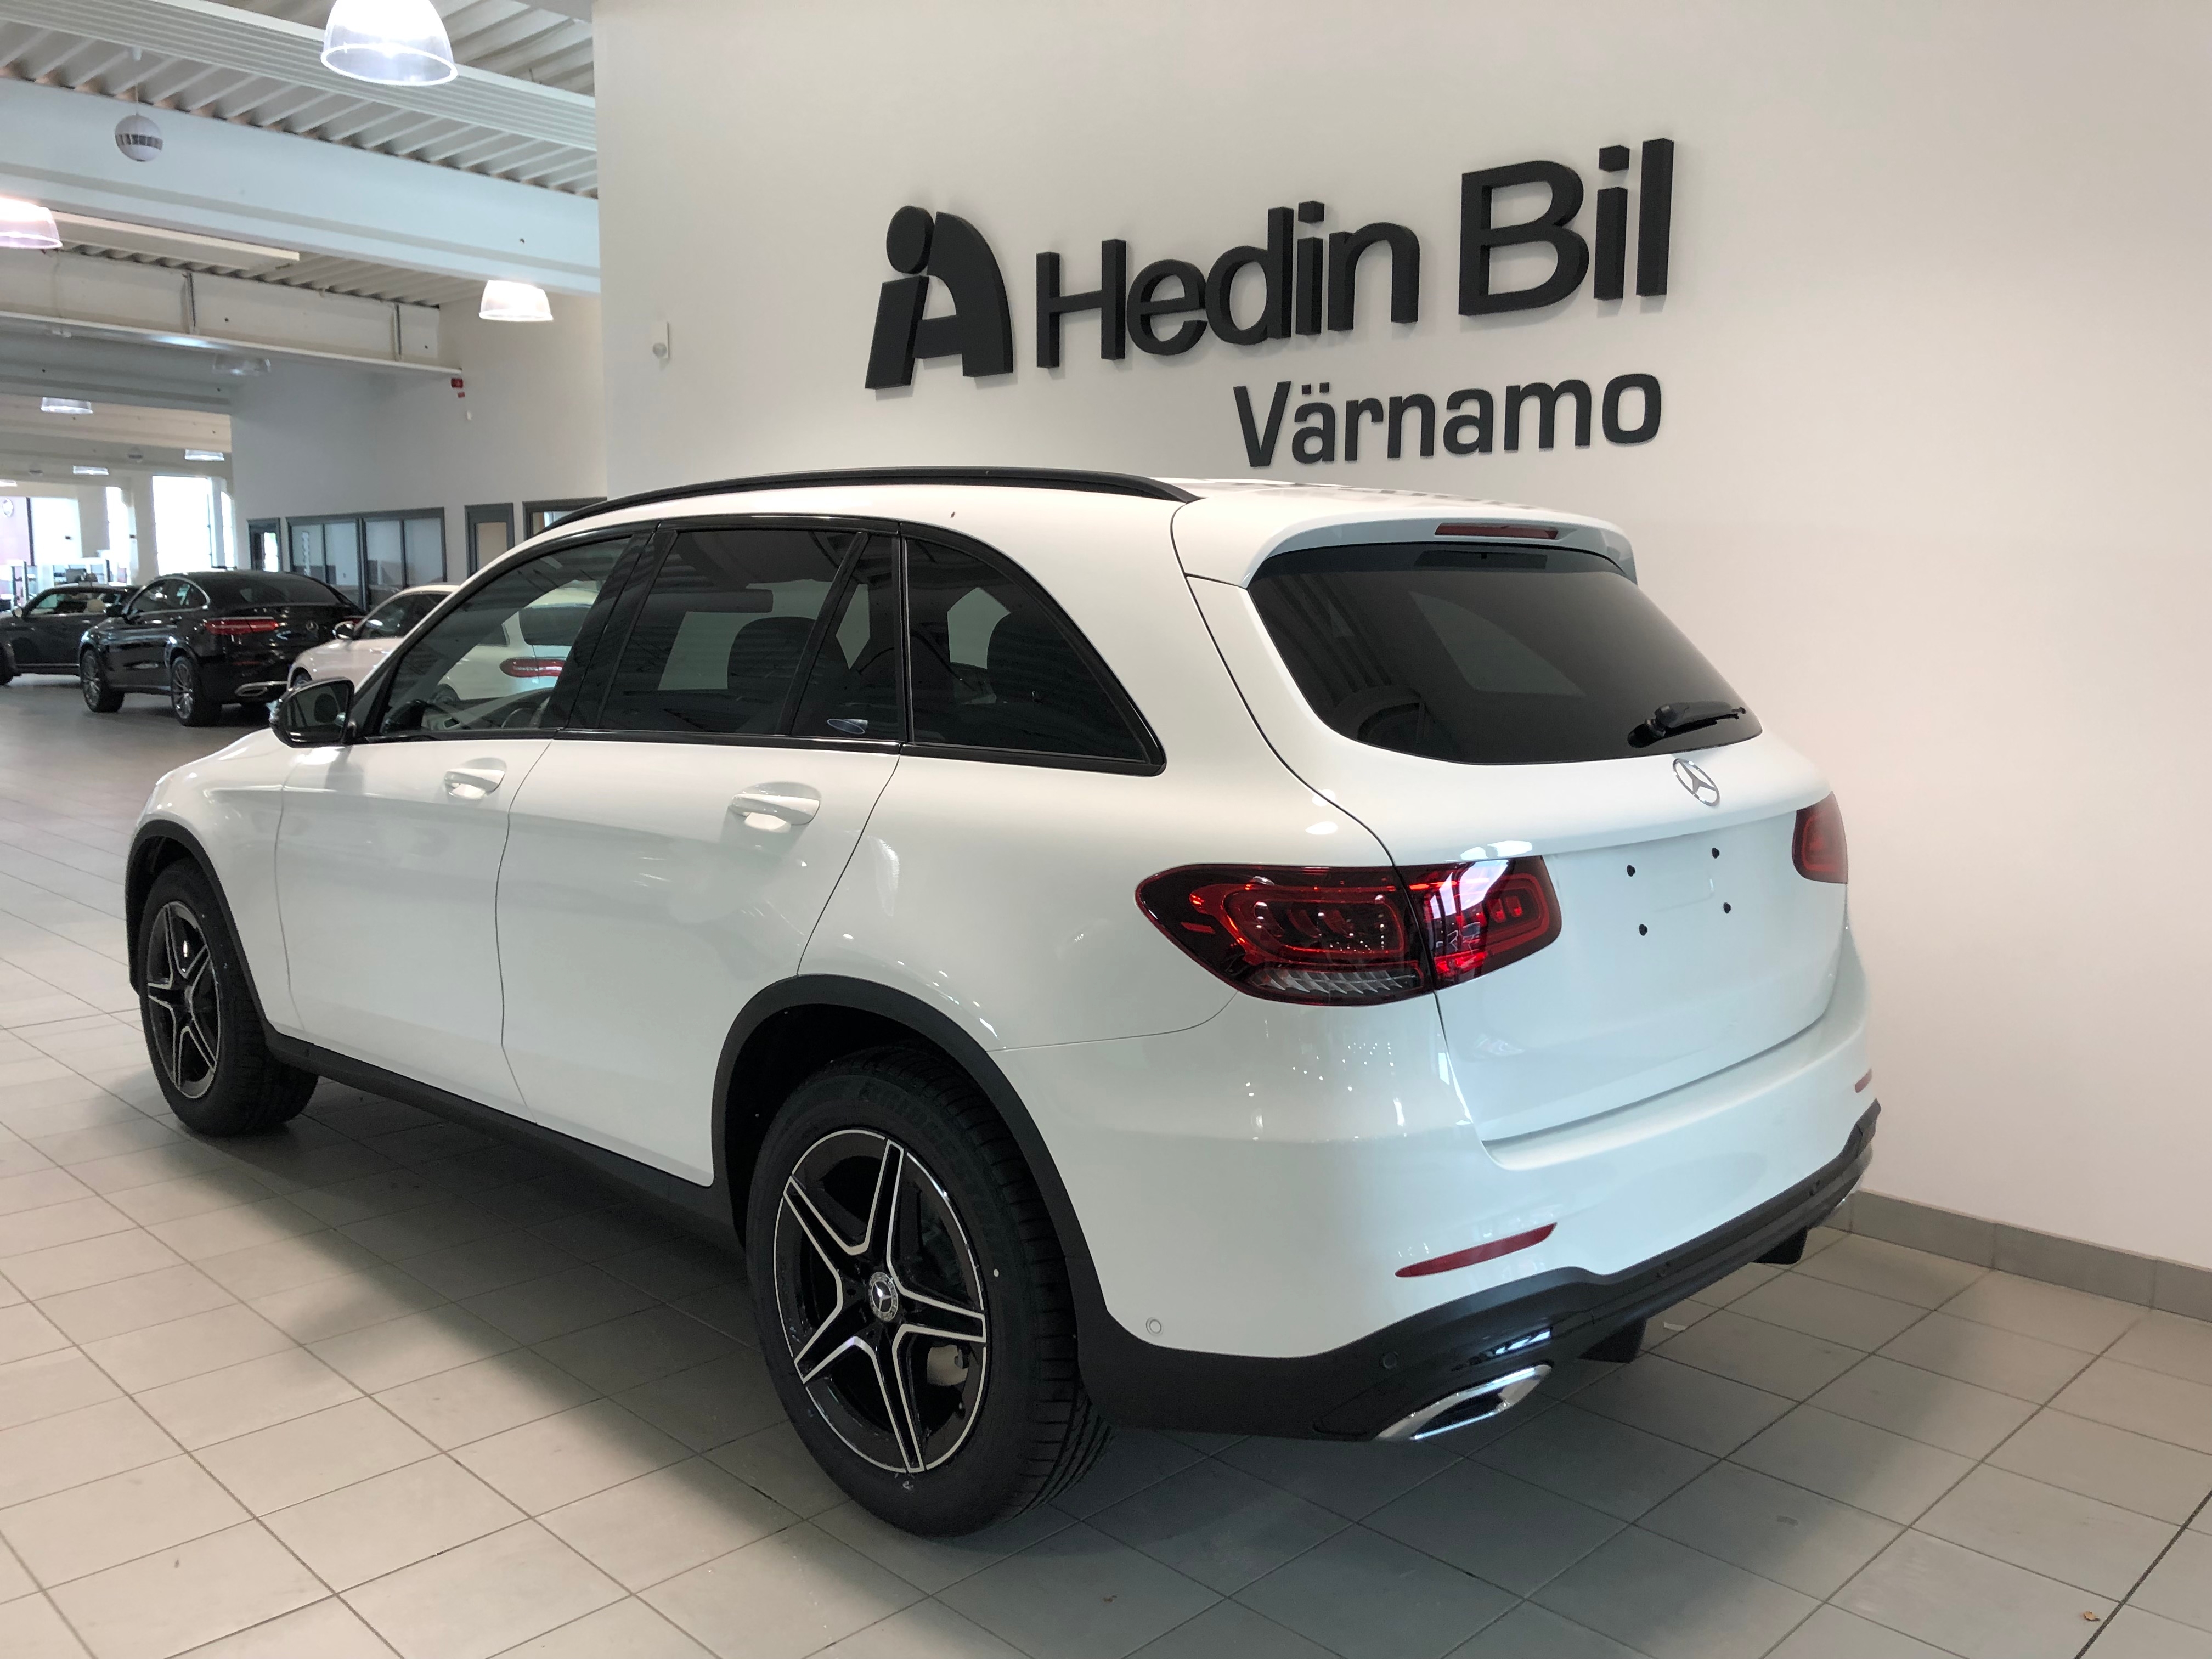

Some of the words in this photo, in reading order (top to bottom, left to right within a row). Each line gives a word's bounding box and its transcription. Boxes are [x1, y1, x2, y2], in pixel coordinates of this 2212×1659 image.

[1036, 201, 1420, 369] Hedin
[1458, 137, 1674, 317] Bil
[1233, 374, 1662, 467] Värnamo
